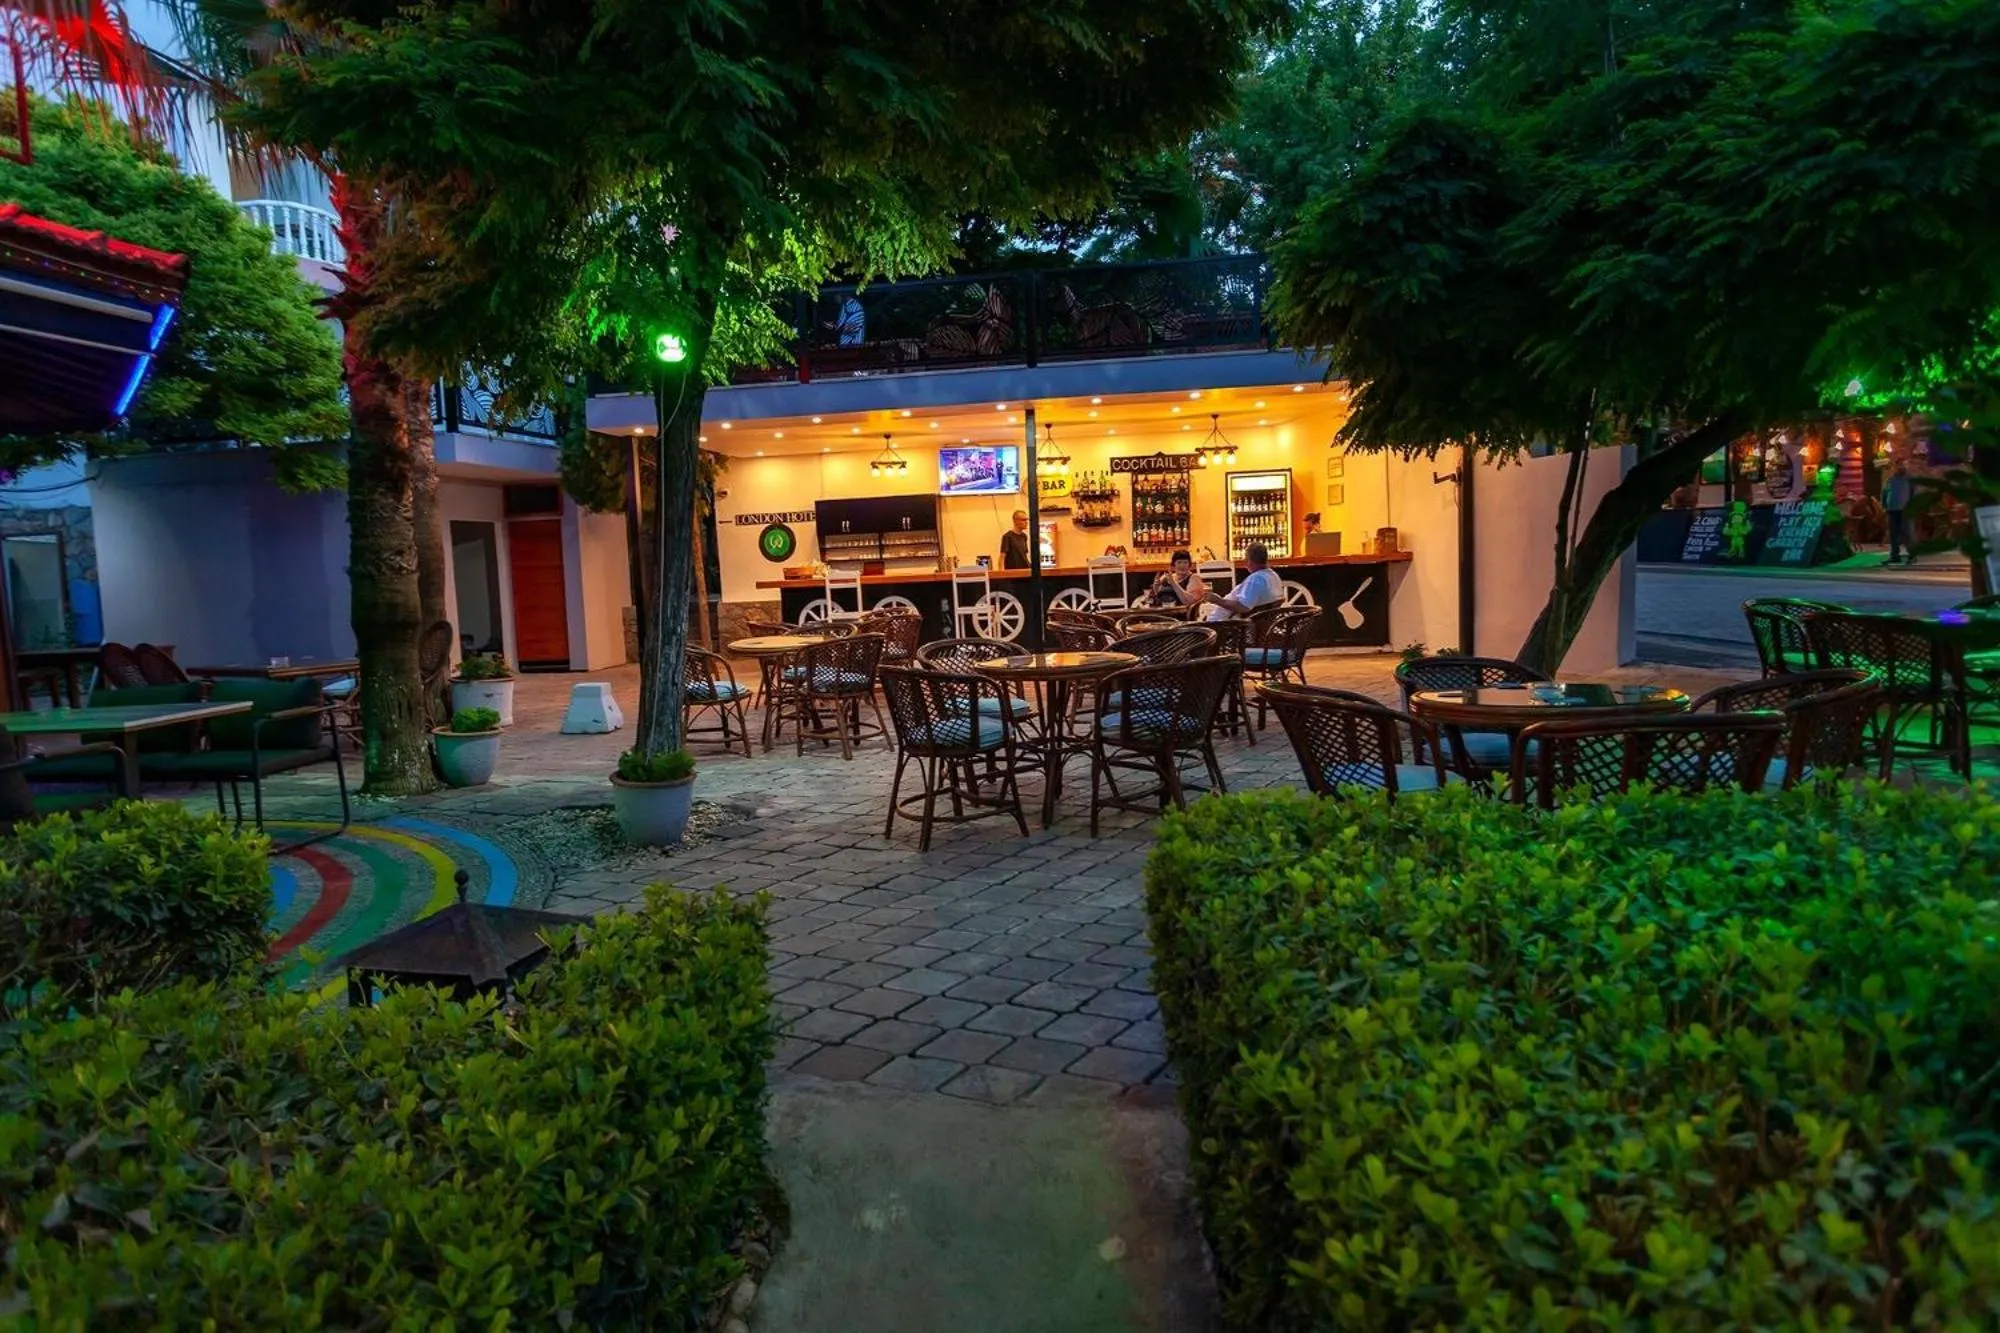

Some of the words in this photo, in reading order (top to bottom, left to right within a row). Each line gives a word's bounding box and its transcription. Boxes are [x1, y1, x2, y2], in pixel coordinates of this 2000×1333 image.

[1112, 457, 1177, 471] COCKTAIL
[1179, 456, 1203, 468] BA
[1042, 479, 1066, 490] BAR
[1773, 500, 1828, 516] WELCOME
[736, 513, 784, 525] LONDON
[787, 511, 817, 523] HOTE
